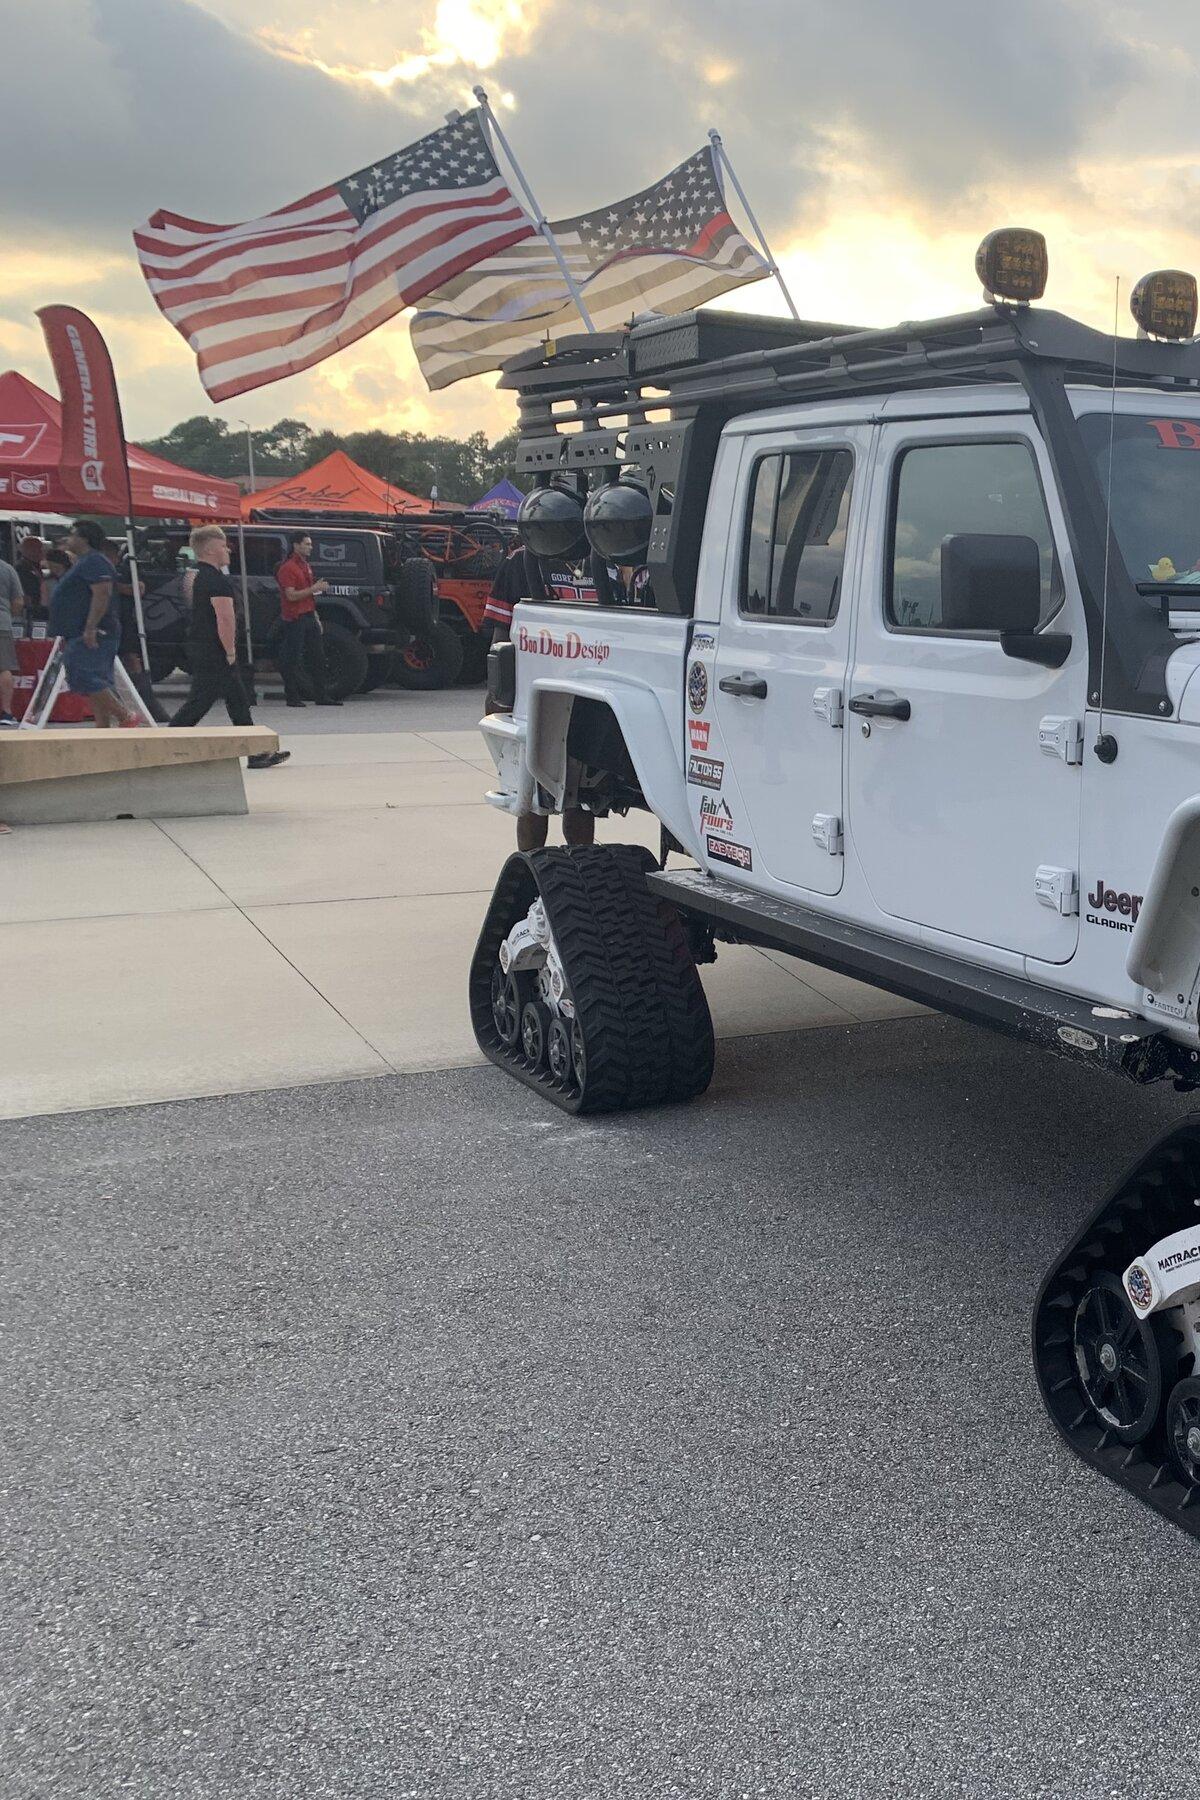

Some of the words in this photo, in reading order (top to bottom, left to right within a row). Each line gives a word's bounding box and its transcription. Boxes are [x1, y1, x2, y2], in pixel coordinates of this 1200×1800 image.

[66, 324, 96, 415] GENERAL
[82, 416, 98, 460] TIRE
[520, 626, 537, 652] Boo
[539, 629, 563, 657] Doo
[566, 632, 610, 665] Design
[689, 760, 712, 777] FACTOR
[713, 764, 723, 780] 55
[708, 838, 750, 866] FABTECH
[1086, 914, 1135, 933] GLADIAT
